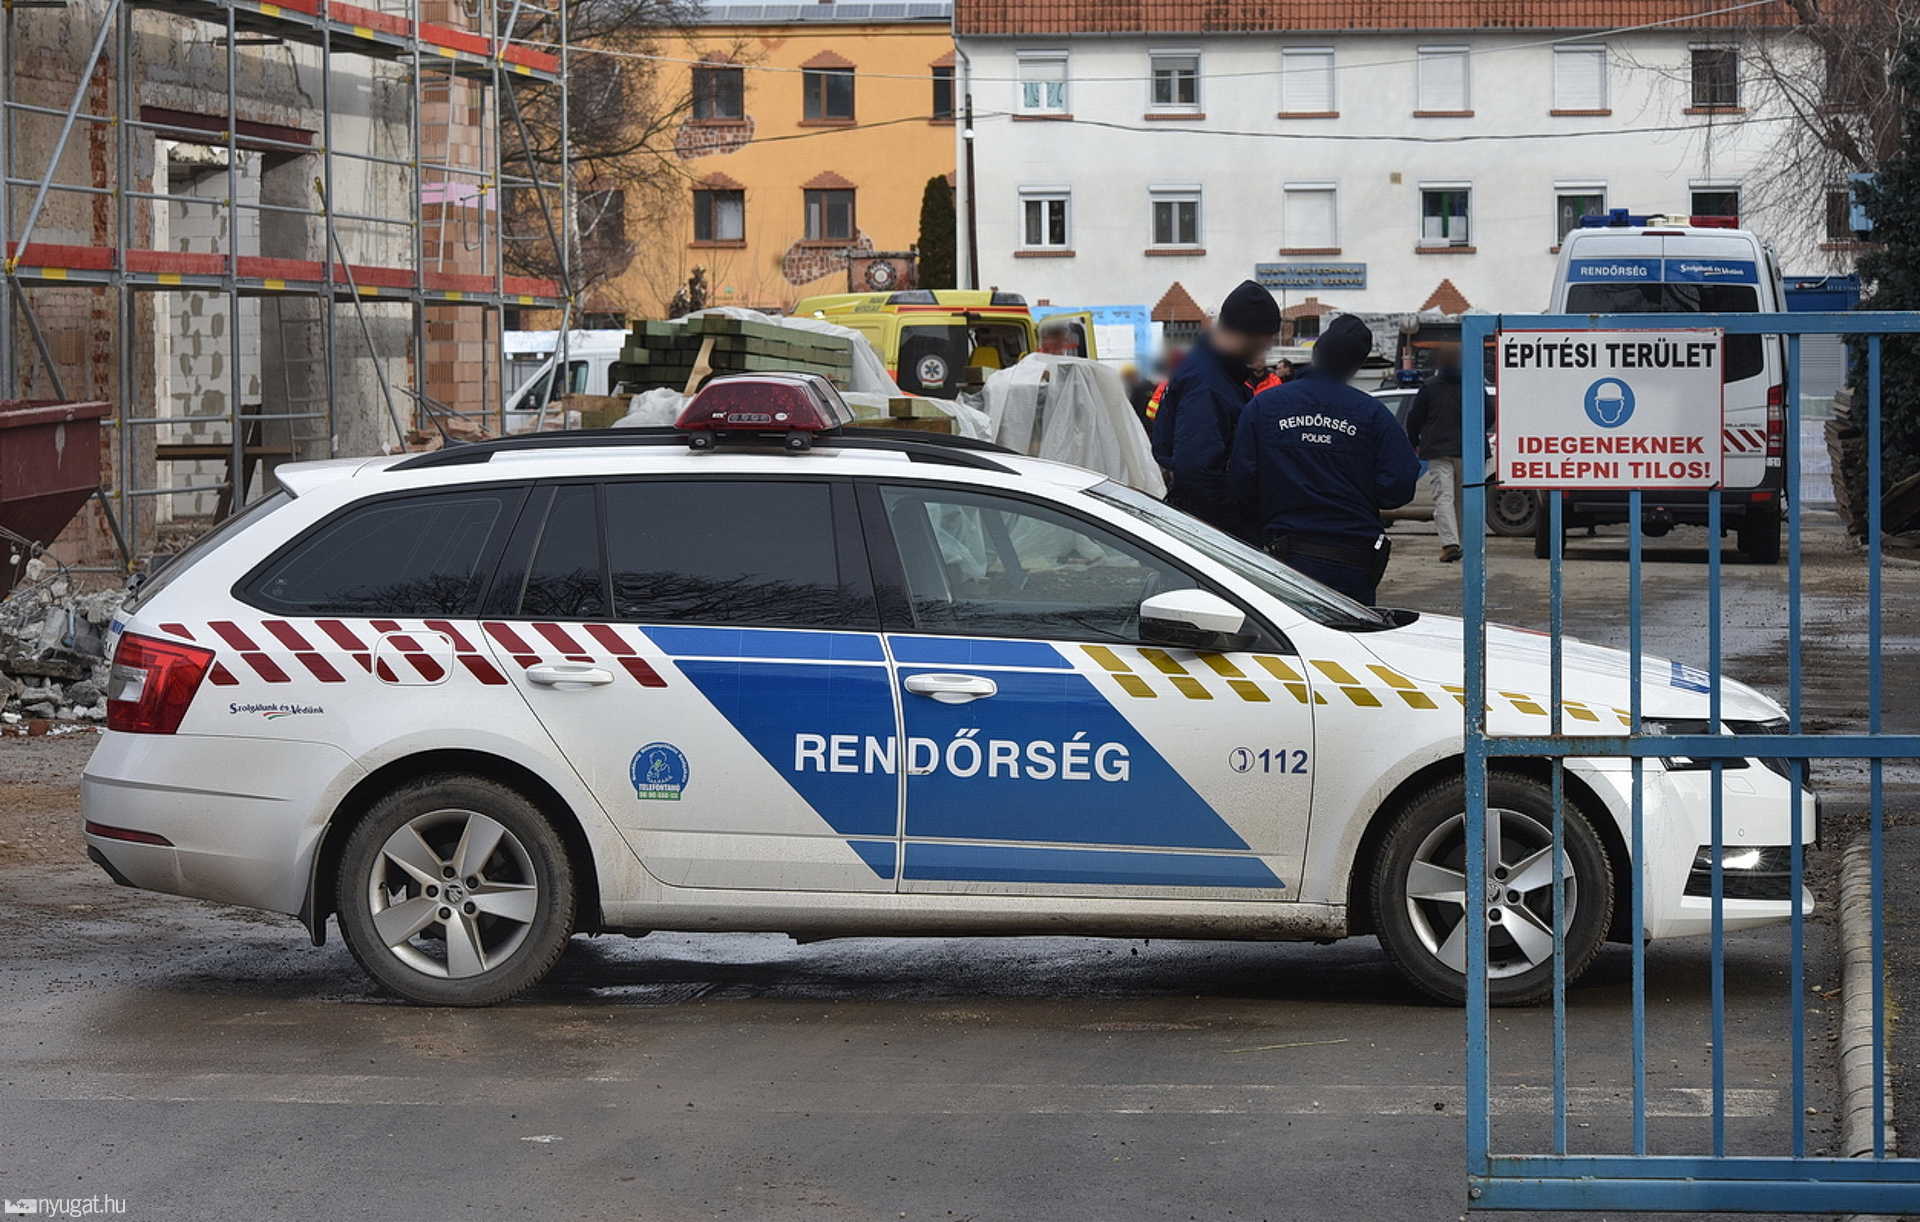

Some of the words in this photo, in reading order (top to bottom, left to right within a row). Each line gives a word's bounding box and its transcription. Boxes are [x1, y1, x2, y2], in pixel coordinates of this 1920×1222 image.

[1580, 264, 1648, 277] RENDŐRSÉG
[1504, 337, 1597, 368] ÉPÍTÉSI
[1606, 338, 1717, 368] TERÜLET
[1278, 413, 1357, 436] RENDŐRSÉG
[1301, 432, 1332, 444] POLICE
[1518, 436, 1704, 454] IDEGENEKNEK
[1511, 457, 1619, 479] BELÉPNI
[1628, 461, 1711, 479] TILOS!
[794, 728, 1131, 782] RENDŐRSÉG
[1258, 748, 1308, 774] 112
